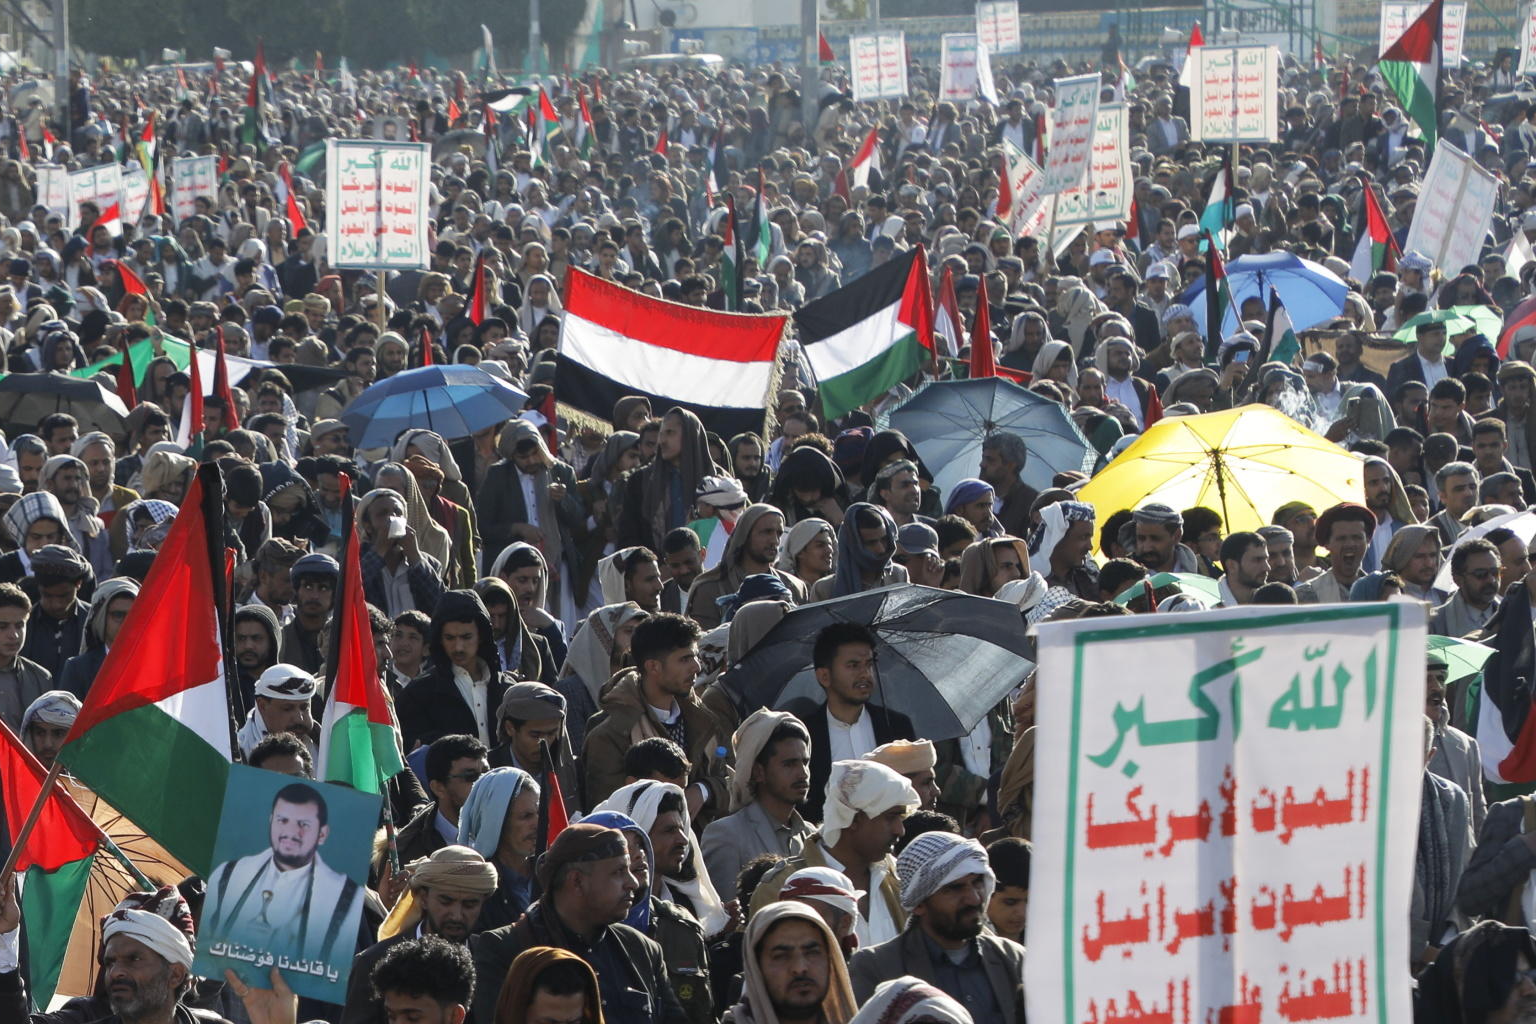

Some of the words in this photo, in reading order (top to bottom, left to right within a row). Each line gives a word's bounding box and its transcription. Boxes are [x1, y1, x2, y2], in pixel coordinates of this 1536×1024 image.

[390, 152, 419, 171] الله
[1085, 637, 1265, 777] أكبر
[1267, 641, 1379, 732] الله
[1085, 764, 1239, 858] لأمريكا
[1250, 766, 1370, 844] الموت
[1081, 875, 1239, 962] لإسرائيل
[1250, 863, 1366, 943] الموت
[277, 955, 324, 976] قائدنا
[326, 964, 339, 982] يا
[1276, 956, 1368, 1024] اللعنة
